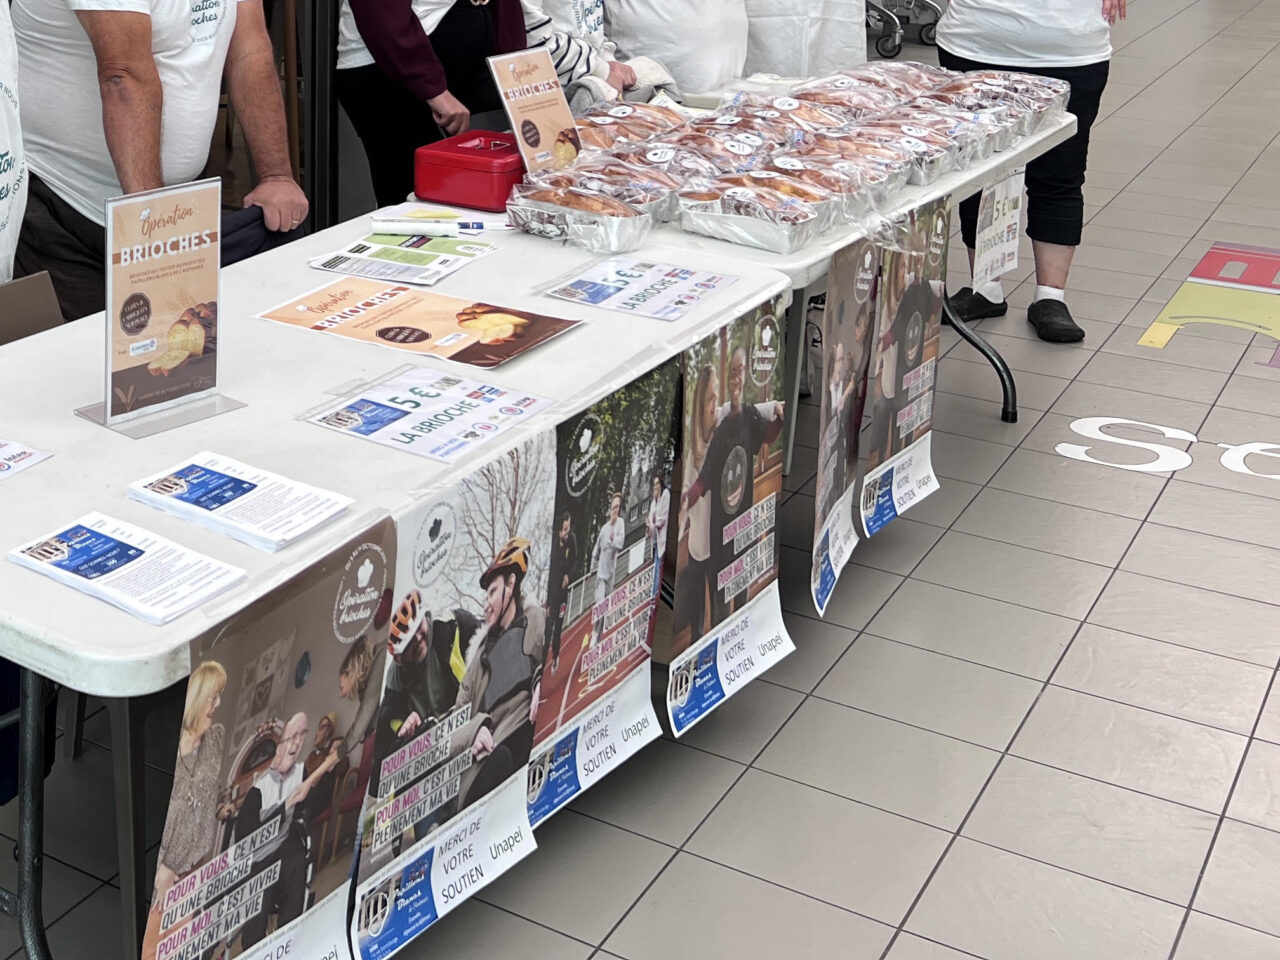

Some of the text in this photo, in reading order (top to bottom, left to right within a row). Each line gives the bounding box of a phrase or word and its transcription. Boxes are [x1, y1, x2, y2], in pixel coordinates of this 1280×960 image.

[120, 229, 212, 268] BRIOCHES
[387, 386, 442, 410] 5 €
[390, 399, 481, 445] LA BRIOCHE
[724, 638, 746, 663] VOTRE
[757, 634, 783, 657] Unapei
[725, 656, 755, 686] SOUTIEN
[585, 724, 610, 751] VOTRE
[621, 715, 650, 742] Unapei
[381, 723, 445, 777] POUR CE
[413, 739, 451, 776] BRIOCHE
[583, 743, 617, 777] SOUTIEN
[376, 751, 472, 827] POUR VIVRE
[373, 803, 427, 849] PLEINEMENT
[438, 817, 482, 857] MERCI DE
[489, 825, 524, 860] Unapei
[443, 843, 474, 874] VOTRE
[441, 864, 484, 904] SOUTIEN
